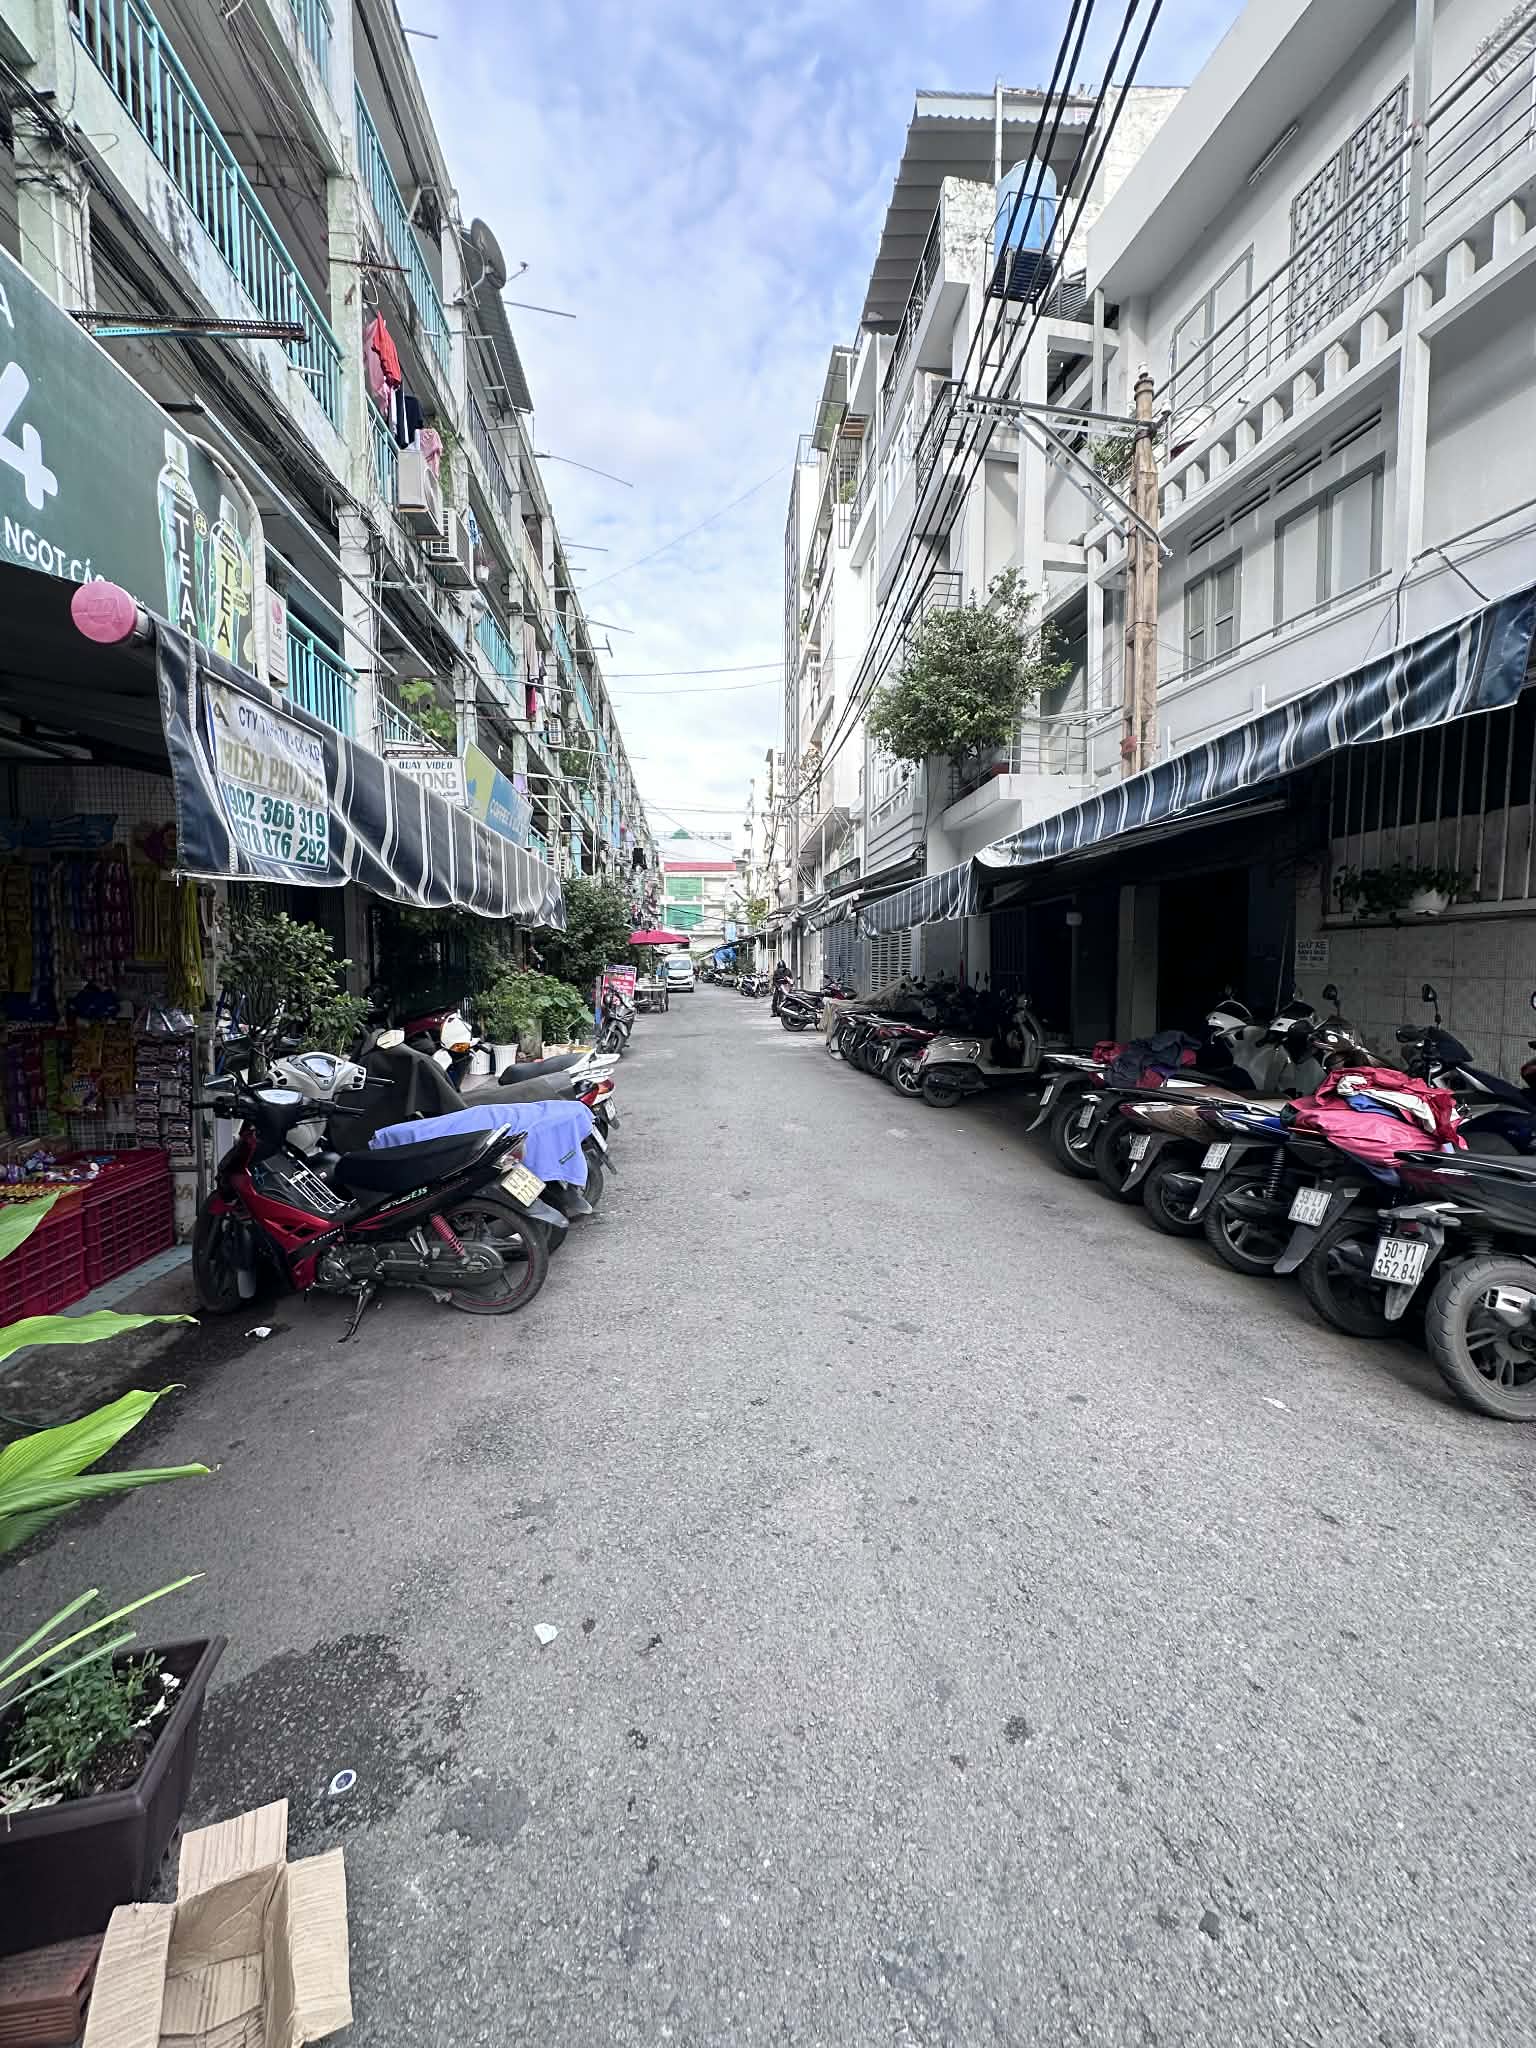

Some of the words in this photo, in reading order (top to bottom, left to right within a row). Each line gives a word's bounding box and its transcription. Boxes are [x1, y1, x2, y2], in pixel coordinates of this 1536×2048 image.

[217, 553, 235, 648] TEA
[239, 706, 258, 731] CTY
[425, 760, 453, 770] VIDEO
[260, 796, 295, 830] 366
[298, 806, 326, 838] 319
[262, 827, 293, 859] 876
[295, 836, 326, 865] 292
[1376, 1258, 1415, 1282] 352.84
